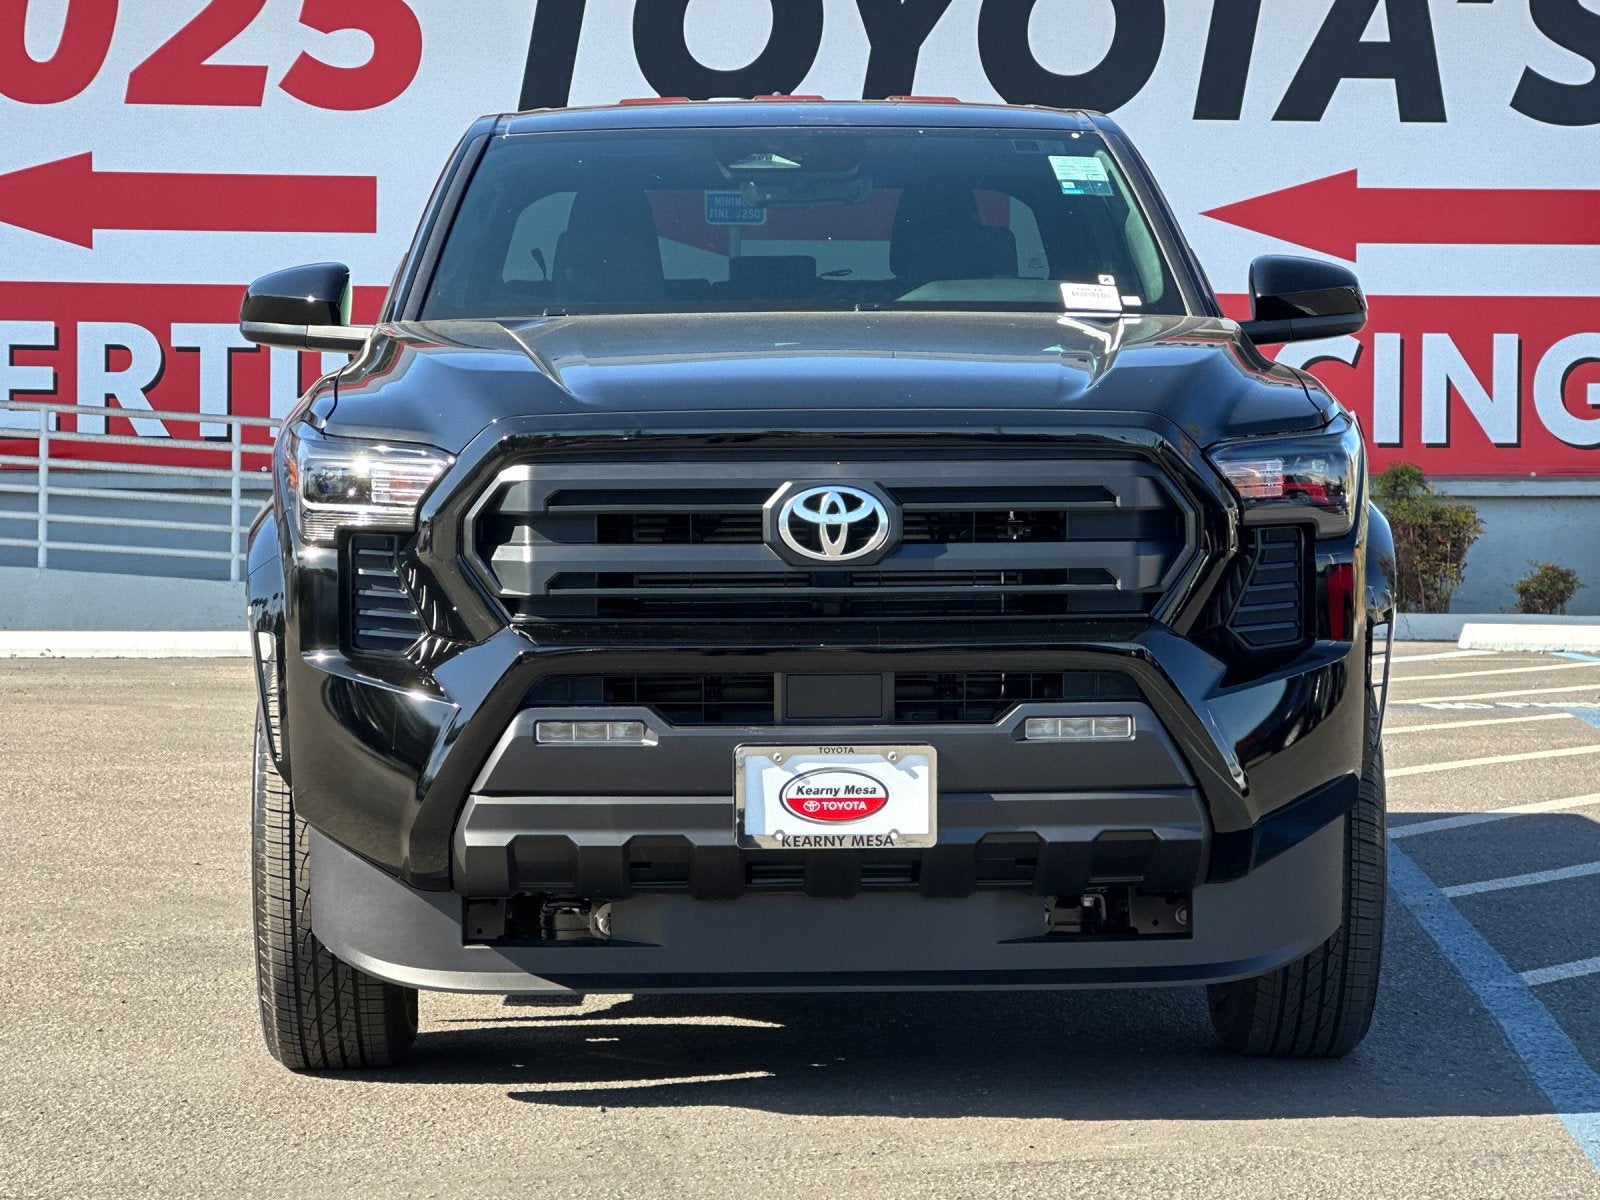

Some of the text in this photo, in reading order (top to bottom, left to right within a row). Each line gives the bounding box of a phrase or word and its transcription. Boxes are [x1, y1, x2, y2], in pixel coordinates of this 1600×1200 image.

[519, 0, 1600, 126] TOYOTAS
[709, 208, 730, 219] FINE
[0, 320, 354, 439] ERTI
[1272, 332, 1600, 449] ING
[796, 785, 877, 797] Kearny Mesa
[822, 801, 867, 810] TOYOTA
[781, 835, 895, 848] KEARNY MESA
